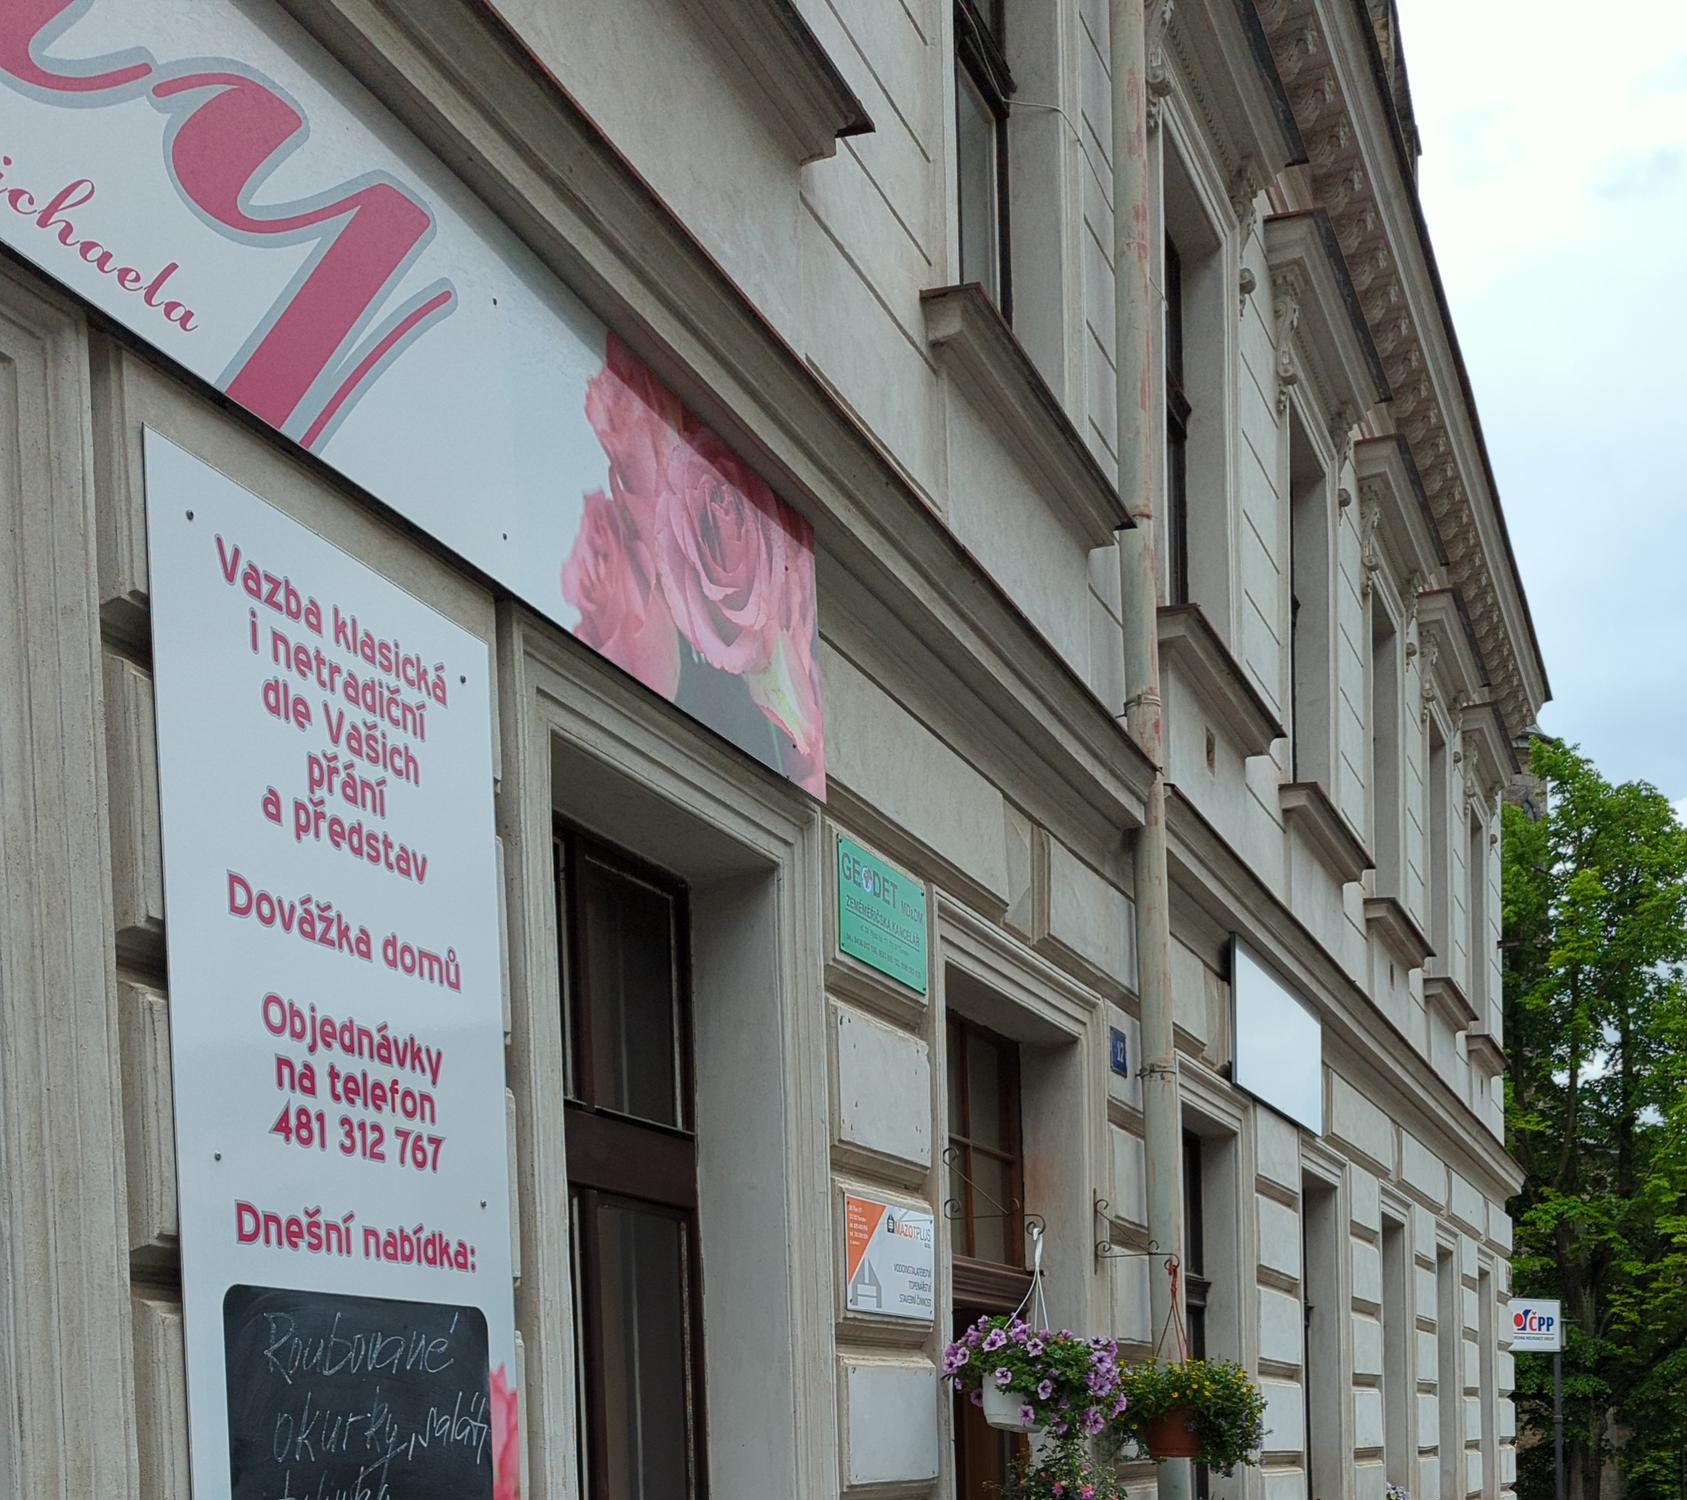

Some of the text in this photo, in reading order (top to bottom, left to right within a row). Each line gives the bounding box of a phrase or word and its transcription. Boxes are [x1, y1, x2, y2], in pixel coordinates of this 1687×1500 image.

[215, 534, 448, 708] Vazba klasická
[248, 607, 426, 742] i netradiční
[262, 676, 420, 786] dle Vašich
[307, 749, 387, 818] přání
[261, 785, 427, 883] a představ
[226, 869, 462, 993] Dovážka domů
[261, 992, 443, 1087] Objednávky
[269, 1100, 446, 1173] 481 312 767
[275, 1053, 436, 1125] na telefon
[234, 1199, 478, 1273] Dnešní nabídka:
[1529, 1311, 1554, 1332] ČPP
